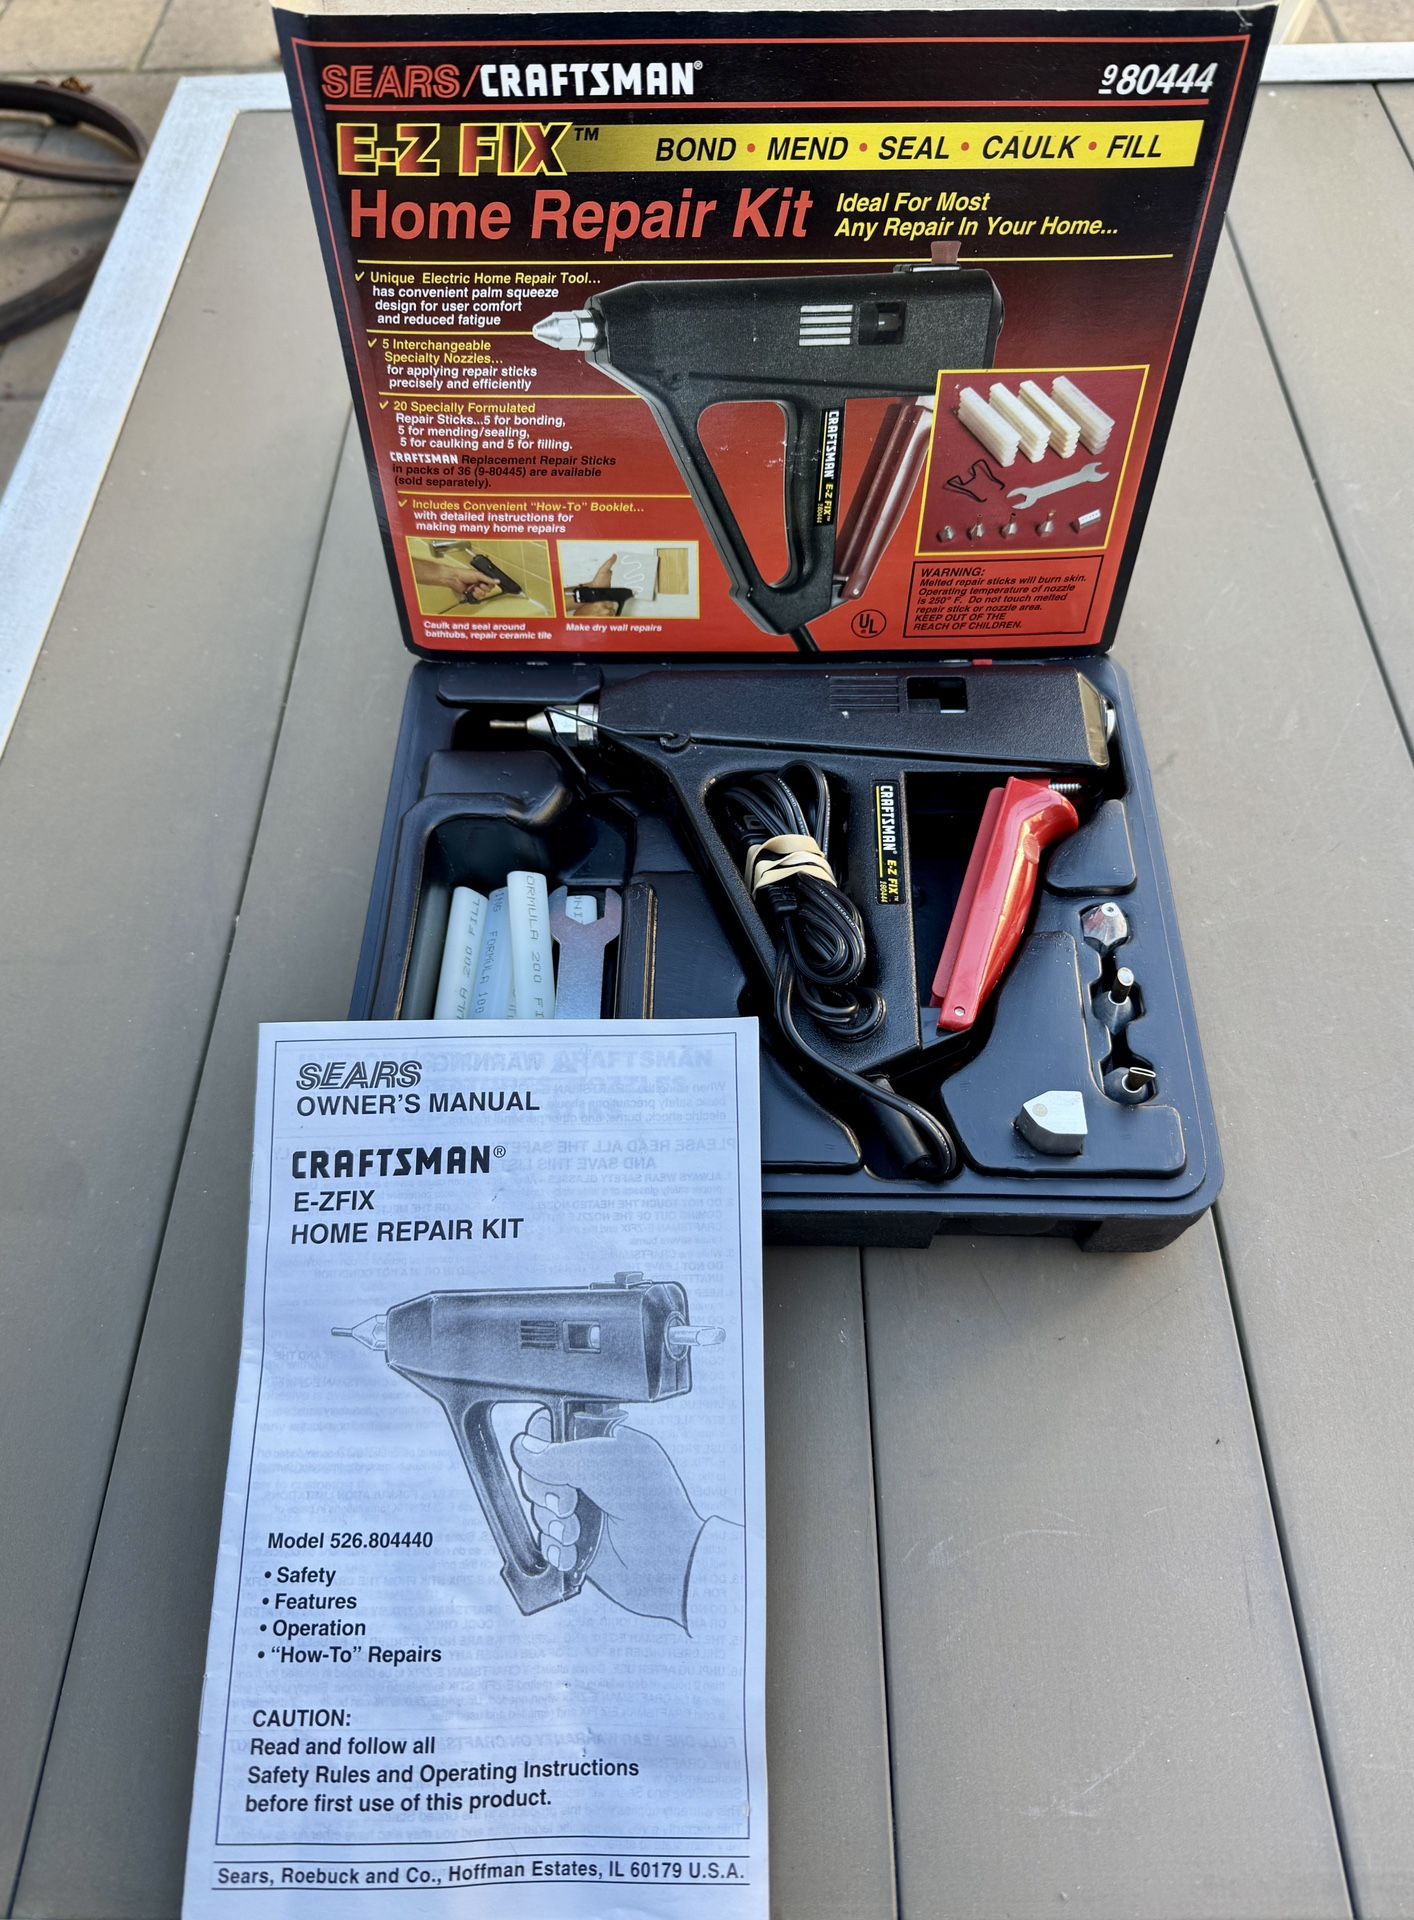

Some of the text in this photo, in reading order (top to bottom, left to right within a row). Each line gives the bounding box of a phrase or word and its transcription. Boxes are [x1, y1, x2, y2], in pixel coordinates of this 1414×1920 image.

[655, 133, 1163, 162] BOND MEND SEAL CAULK FILL
[836, 192, 991, 212] Ideal For Most
[350, 187, 813, 253] Home Repair Kit
[834, 218, 878, 241] Any
[883, 217, 955, 241] Repair
[958, 217, 979, 236] In
[987, 216, 1036, 235] Your
[370, 272, 415, 285] Unique
[422, 272, 470, 284] Electric
[474, 273, 512, 284] Home
[515, 273, 556, 286] Repair
[372, 286, 559, 300] has convenient palm squeeze
[375, 300, 522, 313] design for user comfort
[377, 314, 501, 327] and reduced fatigue
[382, 338, 491, 353] 5 Interchangeable
[384, 352, 440, 365] Specialty
[386, 365, 537, 379] for applying repair sticks
[389, 378, 532, 391] precisely and efficiently
[394, 401, 536, 415] 20 Specially Formulated
[396, 413, 434, 426] Repair
[494, 415, 510, 426] for
[514, 415, 566, 427] bonding,
[397, 426, 405, 435] 5
[408, 426, 424, 436] for
[400, 437, 573, 452] 5 for caulking and 5 for filling.
[390, 452, 616, 468] CRAFTSMAN Replacement Repair Sticks
[412, 500, 460, 510] Includes
[463, 501, 527, 511] Convenient
[414, 511, 574, 523] with detailed instructions for
[416, 522, 566, 535] making many home repairs
[921, 567, 985, 577] WARNING:
[566, 623, 662, 634] Make dry wall repairs
[296, 1060, 422, 1090] SEARS
[429, 1091, 540, 1113] MANUAL
[293, 1190, 375, 1212] E-ZFIX
[291, 1218, 524, 1245] HOME REPAIR KIT
[268, 1532, 433, 1549] Model 526.804440
[276, 1567, 336, 1587] Safety
[275, 1593, 357, 1609] Features
[273, 1619, 366, 1640] Operation
[368, 1645, 442, 1667] Repairs
[252, 1708, 351, 1728] CAUTION:
[250, 1736, 435, 1755] Read and follow all
[248, 1758, 639, 1788] Safety Rules and Operating Instructions
[245, 1788, 552, 1813] before first use of this product.
[217, 1860, 745, 1886] Sears, Roebuck and Co., Hoffman Estates, IL 60179 U.S.A.
